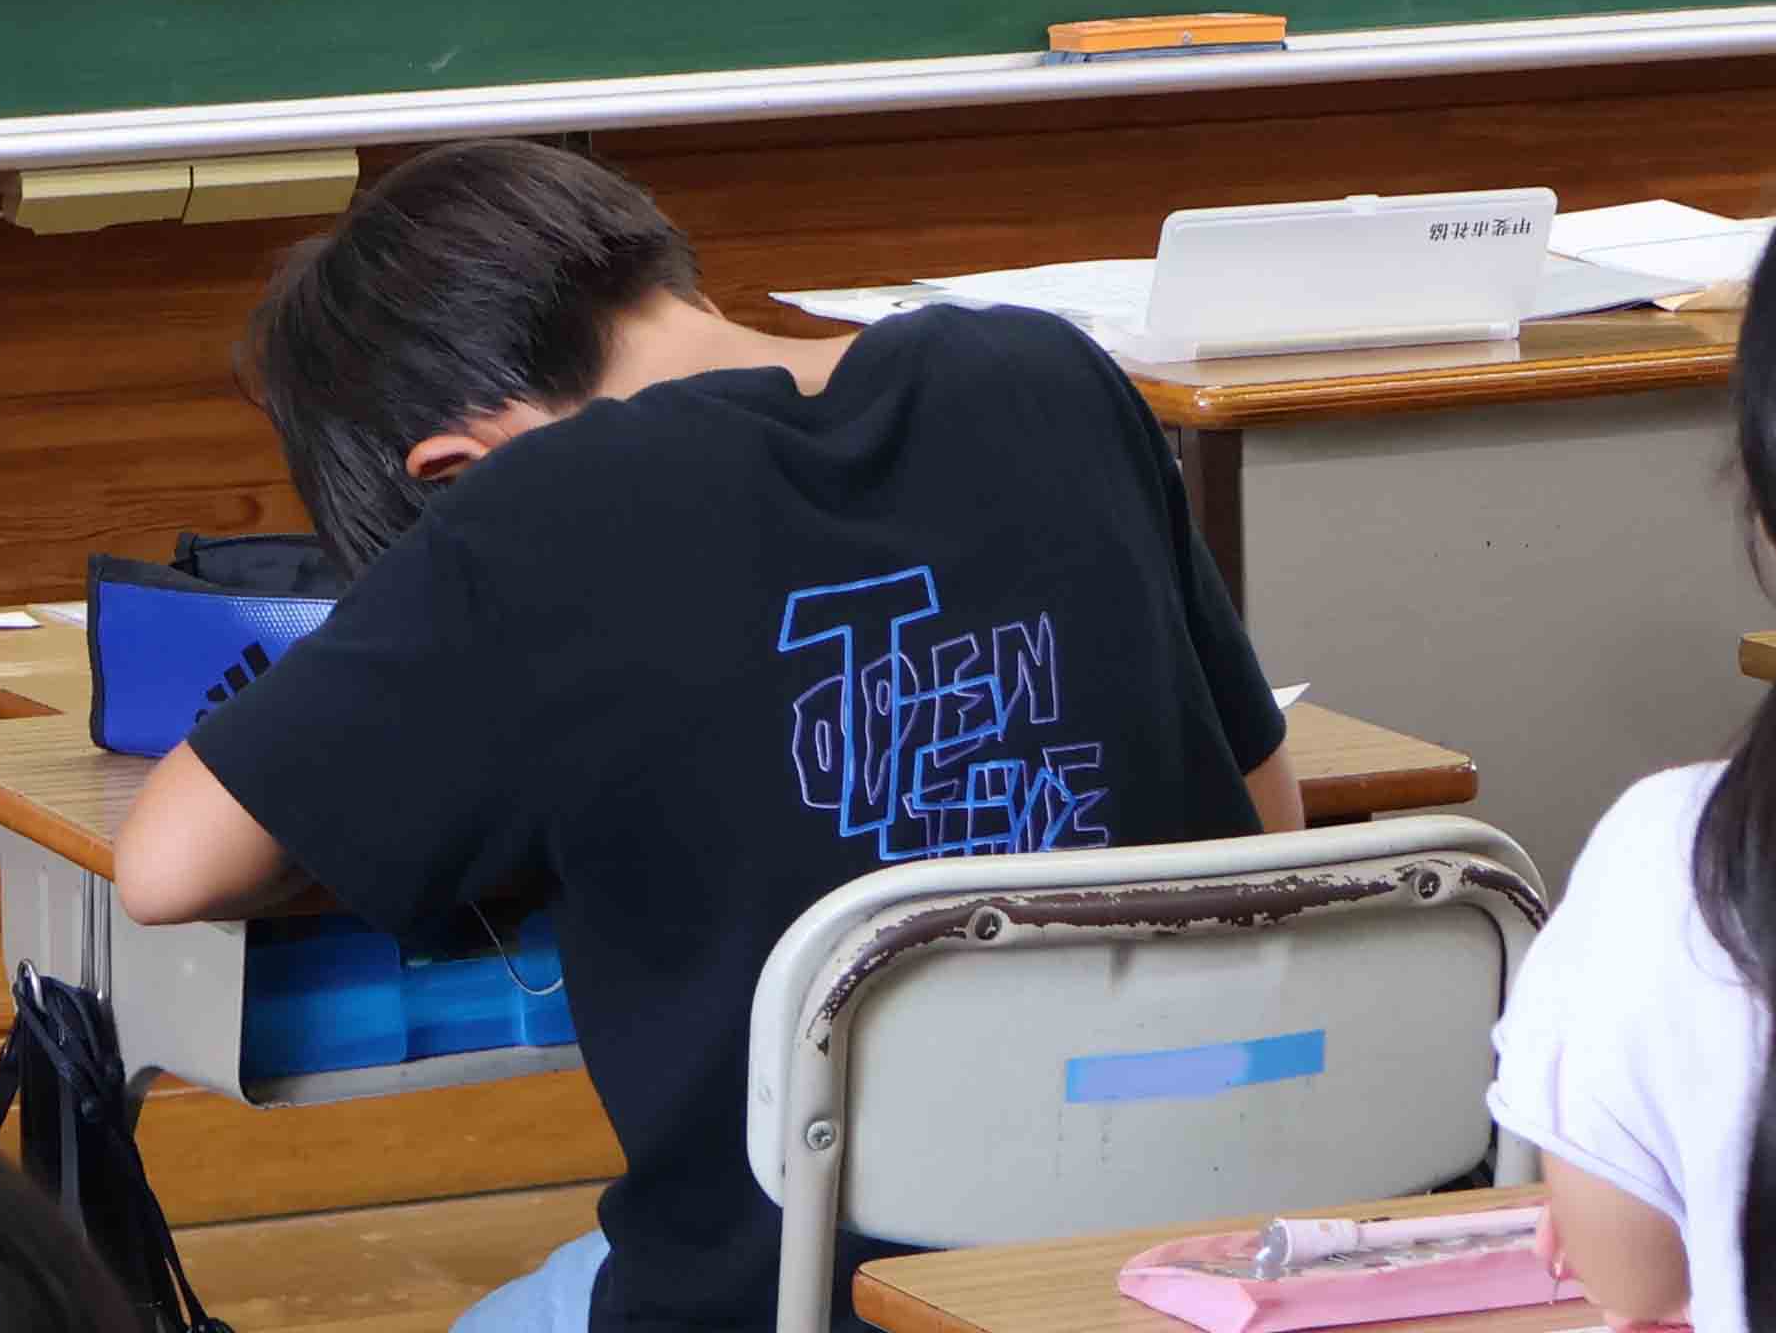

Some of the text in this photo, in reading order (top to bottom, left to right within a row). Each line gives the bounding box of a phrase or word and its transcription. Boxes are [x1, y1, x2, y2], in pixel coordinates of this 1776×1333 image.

[1429, 217, 1531, 242] 甲斐市社協
